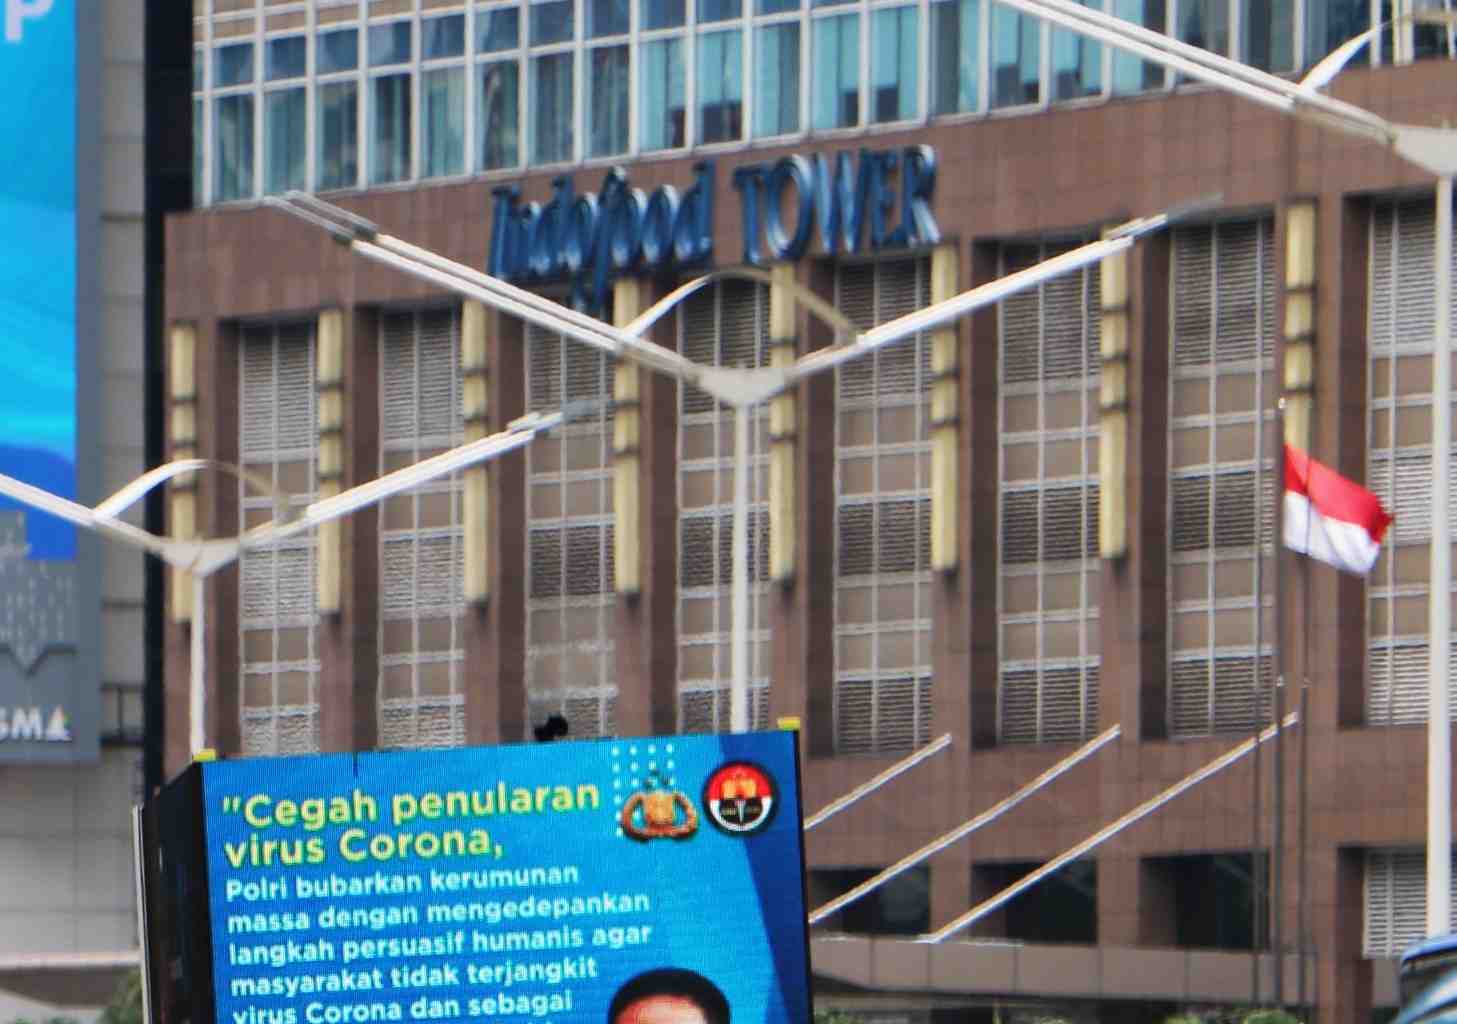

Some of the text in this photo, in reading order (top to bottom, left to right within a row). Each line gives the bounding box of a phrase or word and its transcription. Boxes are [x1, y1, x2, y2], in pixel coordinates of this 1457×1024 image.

[733, 144, 941, 264] TOWER
[392, 780, 600, 826] penularan
[224, 828, 502, 868] virus Corona,
[226, 864, 579, 902] Polri bubarkan kerumunan
[228, 891, 650, 934] massa dengan mengedepankan
[229, 925, 653, 967] langkah persuasif humanis agar
[231, 957, 599, 998] masyarakat tidak terjangkit
[305, 1001, 402, 1024] Corona
[410, 996, 460, 1019] dan
[468, 988, 572, 1017] sebagai
